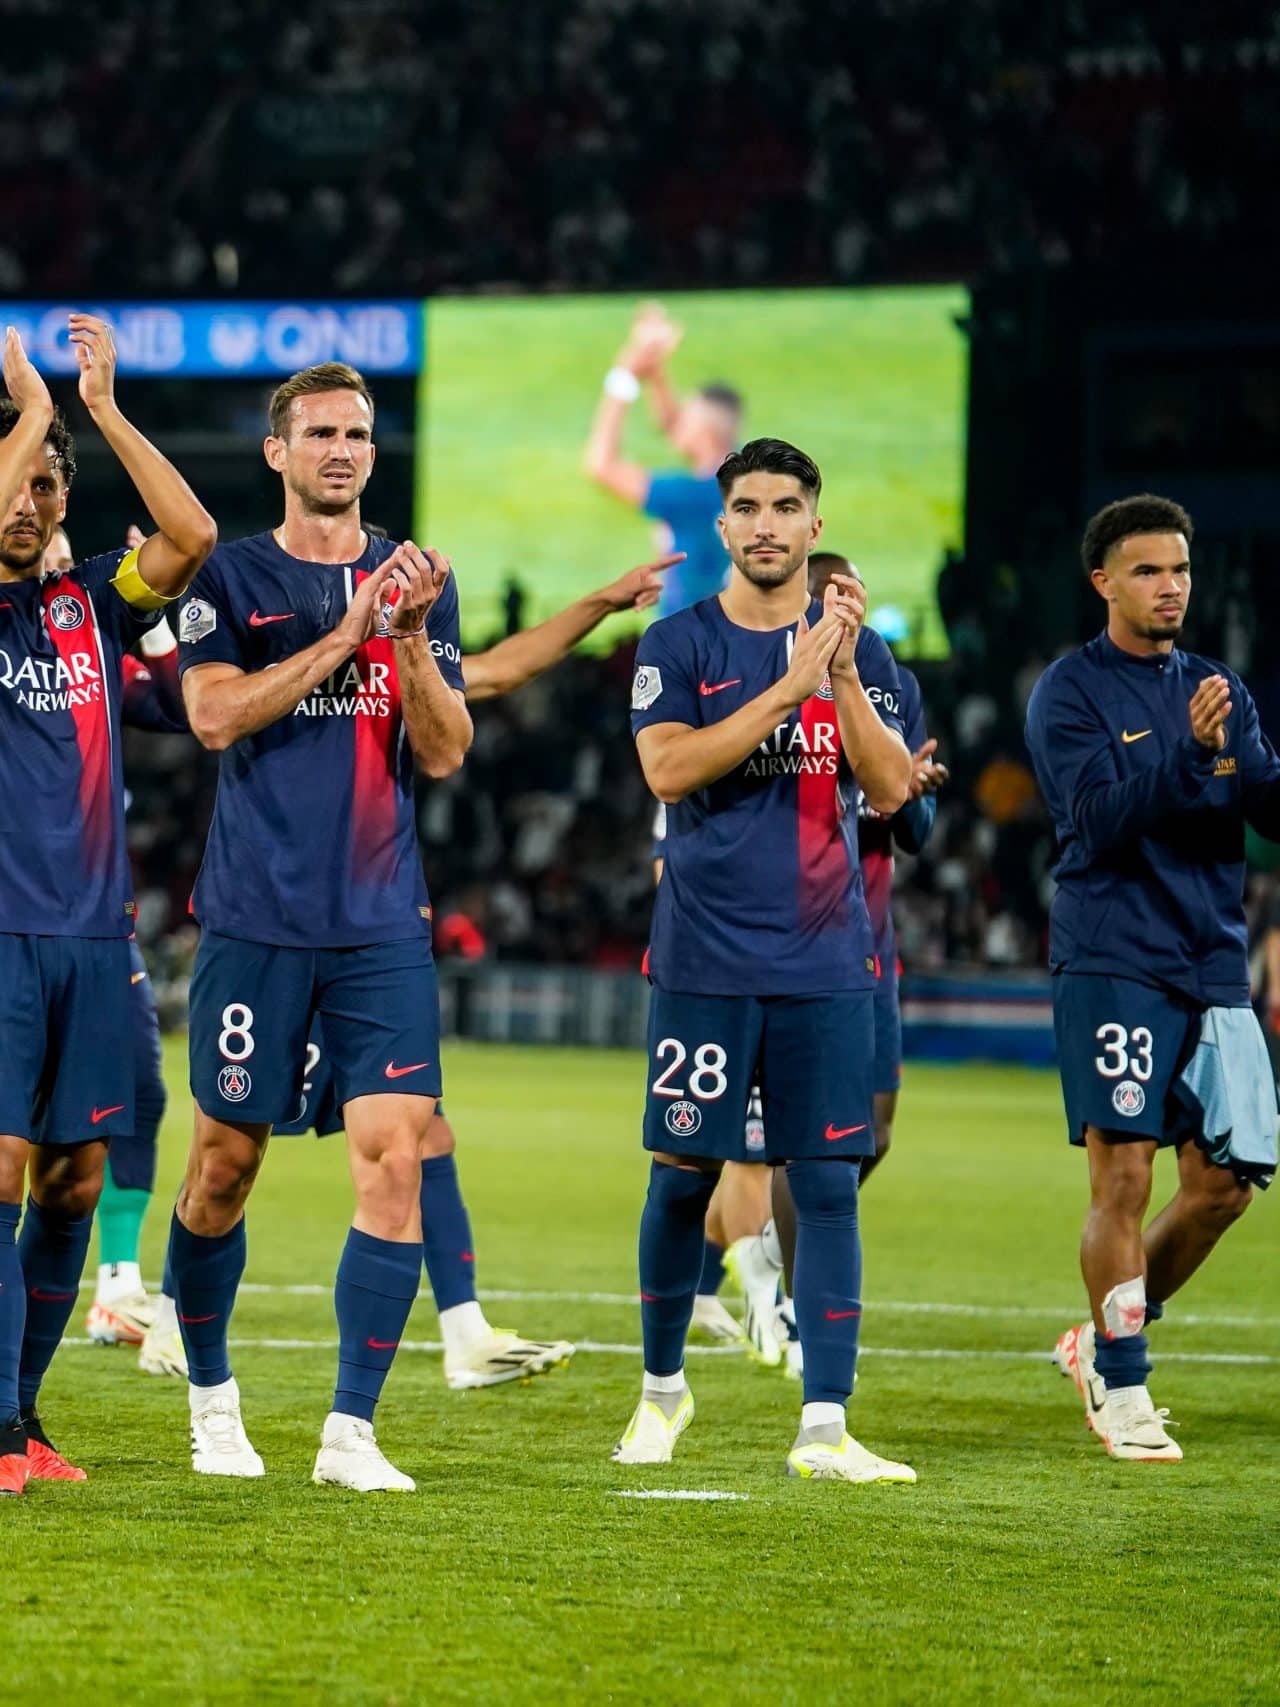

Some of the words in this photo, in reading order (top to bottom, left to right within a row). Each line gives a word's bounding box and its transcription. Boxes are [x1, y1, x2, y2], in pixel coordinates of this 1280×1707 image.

[265, 306, 409, 370] QNB
[16, 680, 100, 711] AIRWAYS
[294, 696, 390, 717] AIRWAYS
[760, 721, 838, 755] TAR
[744, 755, 837, 776] AIRWAYS
[218, 1002, 255, 1062] 8
[1095, 1022, 1153, 1082] 33
[652, 1037, 728, 1100] 28
